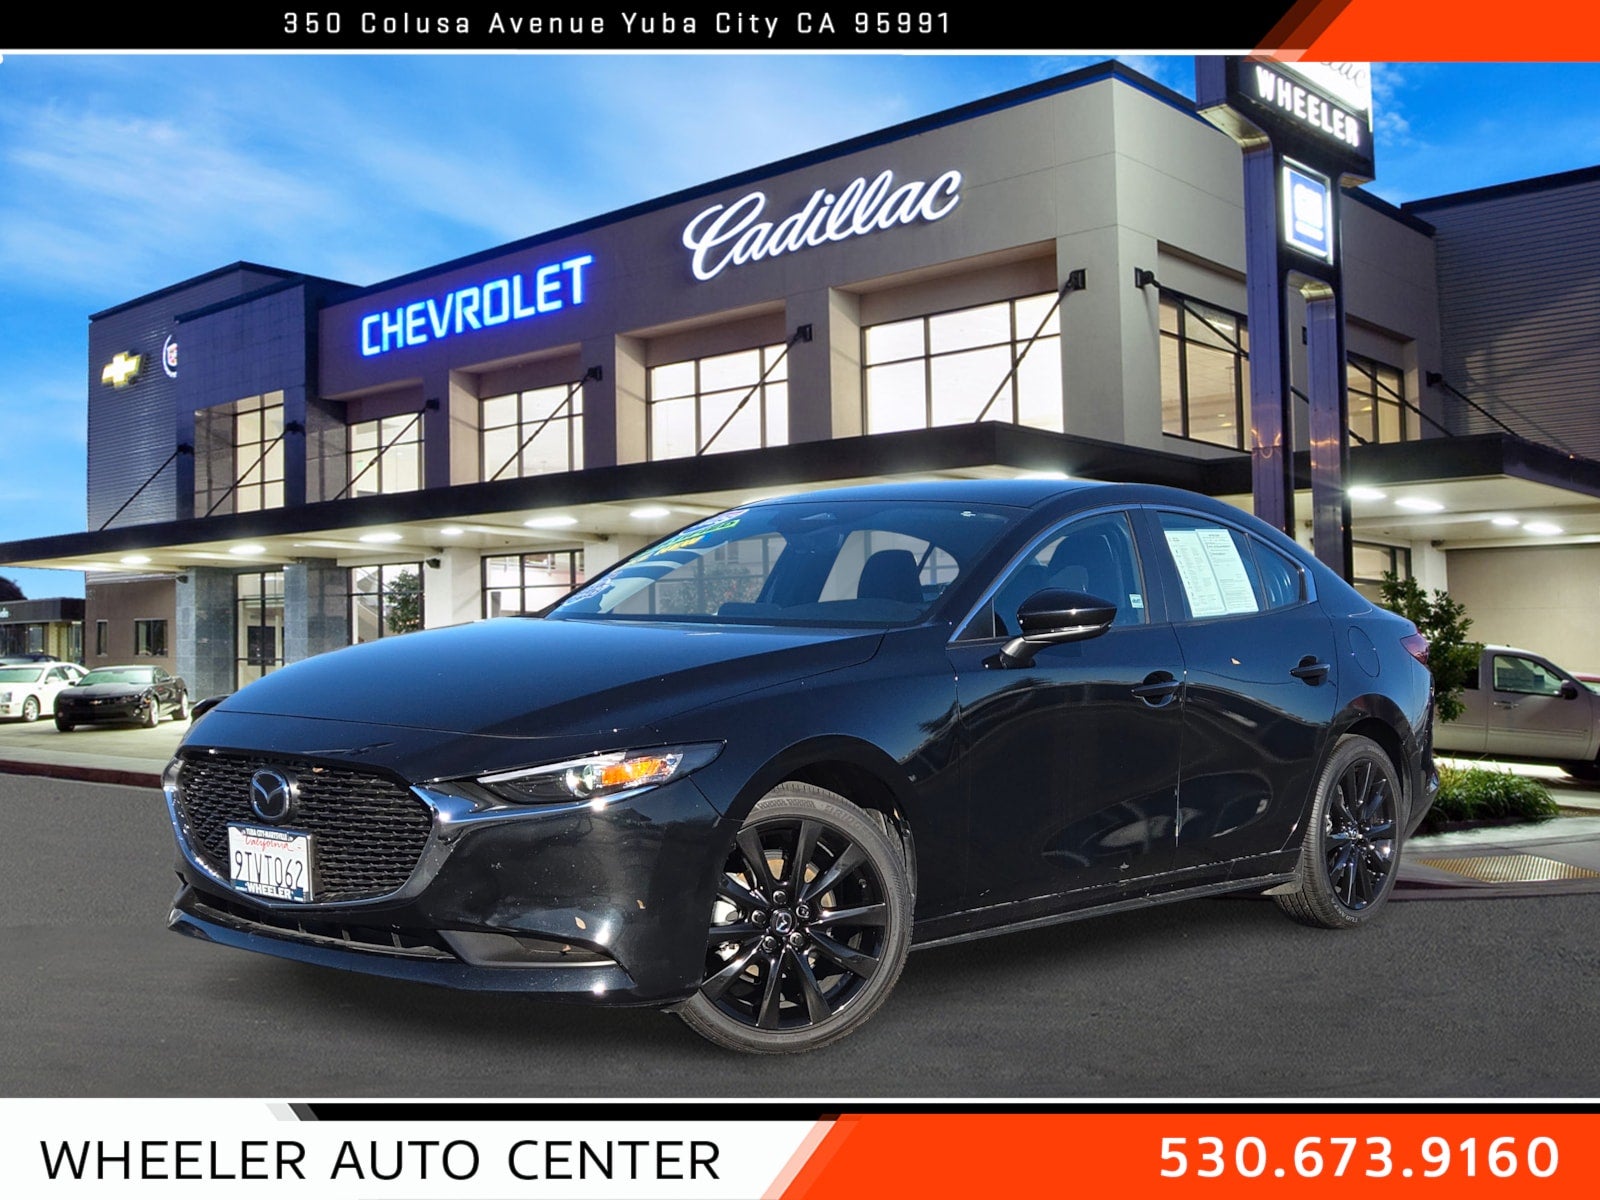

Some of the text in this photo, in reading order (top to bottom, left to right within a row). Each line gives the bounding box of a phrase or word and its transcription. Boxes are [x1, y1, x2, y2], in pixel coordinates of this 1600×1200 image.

[1255, 65, 1359, 147] WHEELER
[682, 169, 962, 281] Cadillac
[361, 254, 594, 357] CHEVROLET
[235, 850, 303, 889] 9TVT062
[247, 882, 292, 899] WHEELER
